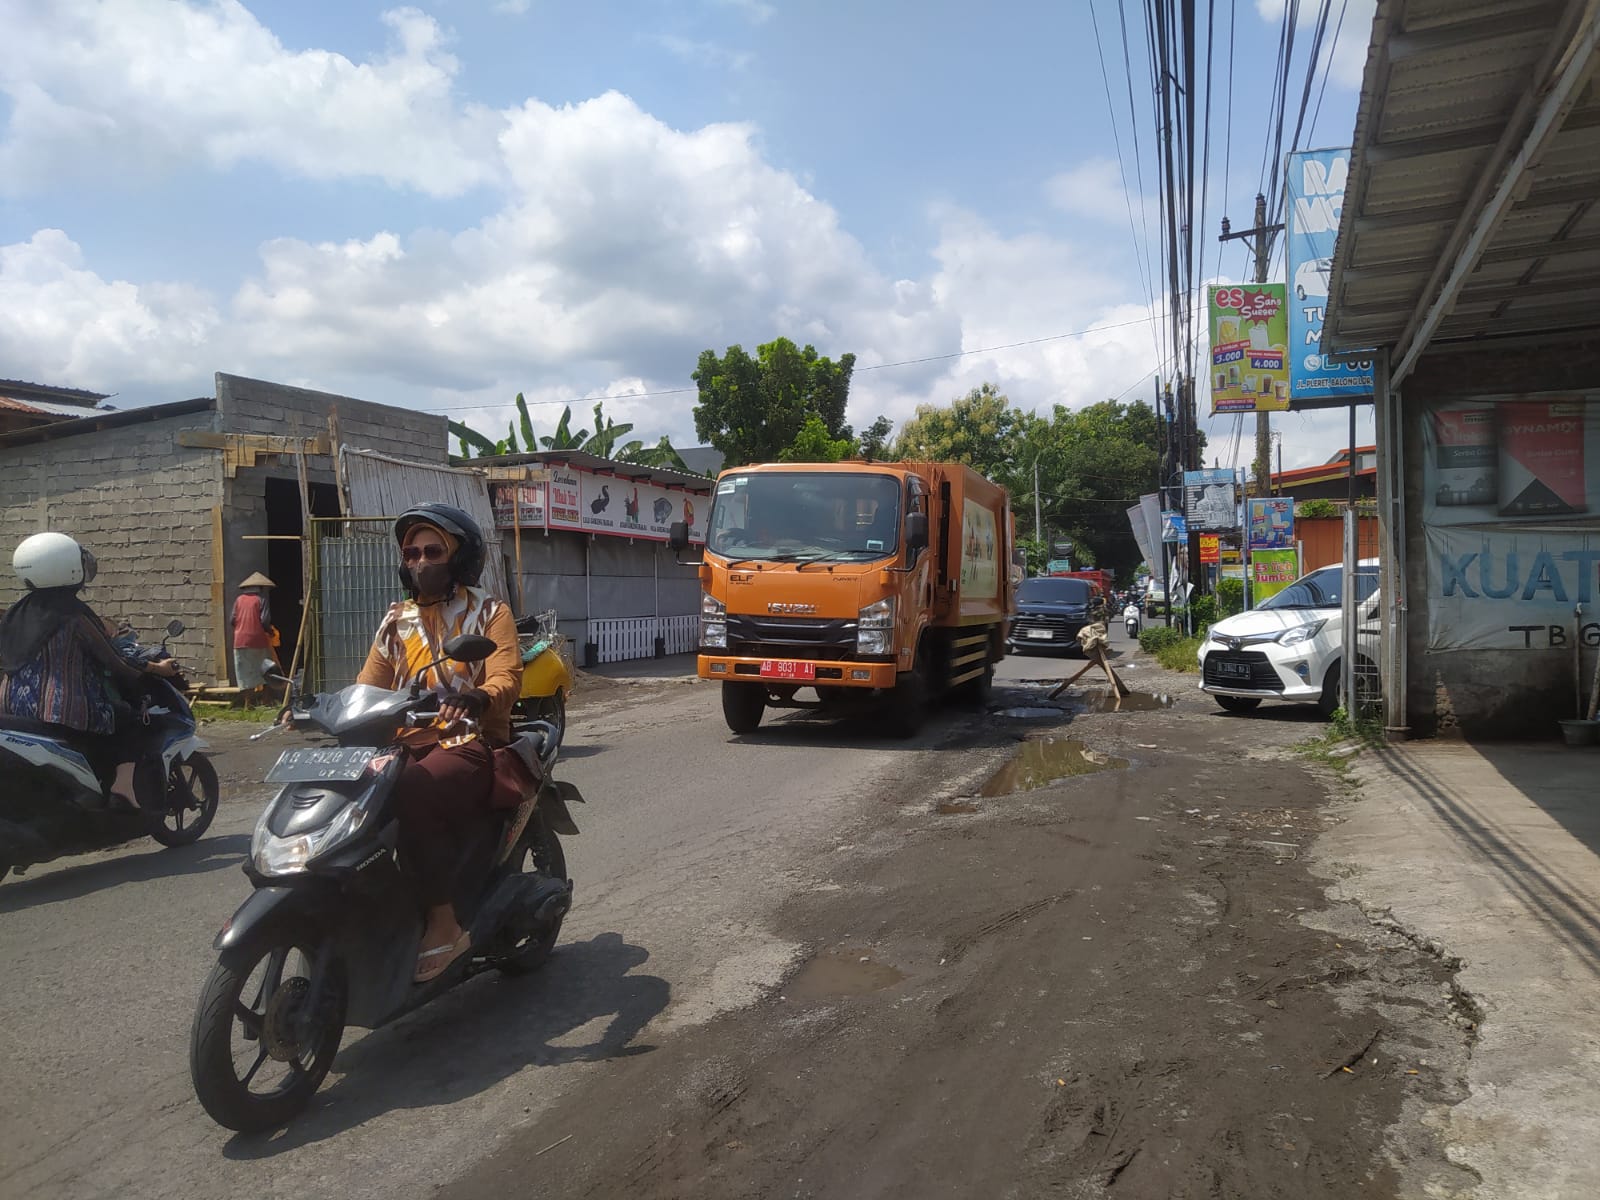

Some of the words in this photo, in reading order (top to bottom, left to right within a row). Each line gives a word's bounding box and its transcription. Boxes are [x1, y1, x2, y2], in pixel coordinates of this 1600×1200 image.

[1216, 350, 1241, 363] 3.000
[1254, 359, 1280, 369] 4.000
[1256, 573, 1296, 583] Jumbo
[767, 602, 817, 614] ISUZU
